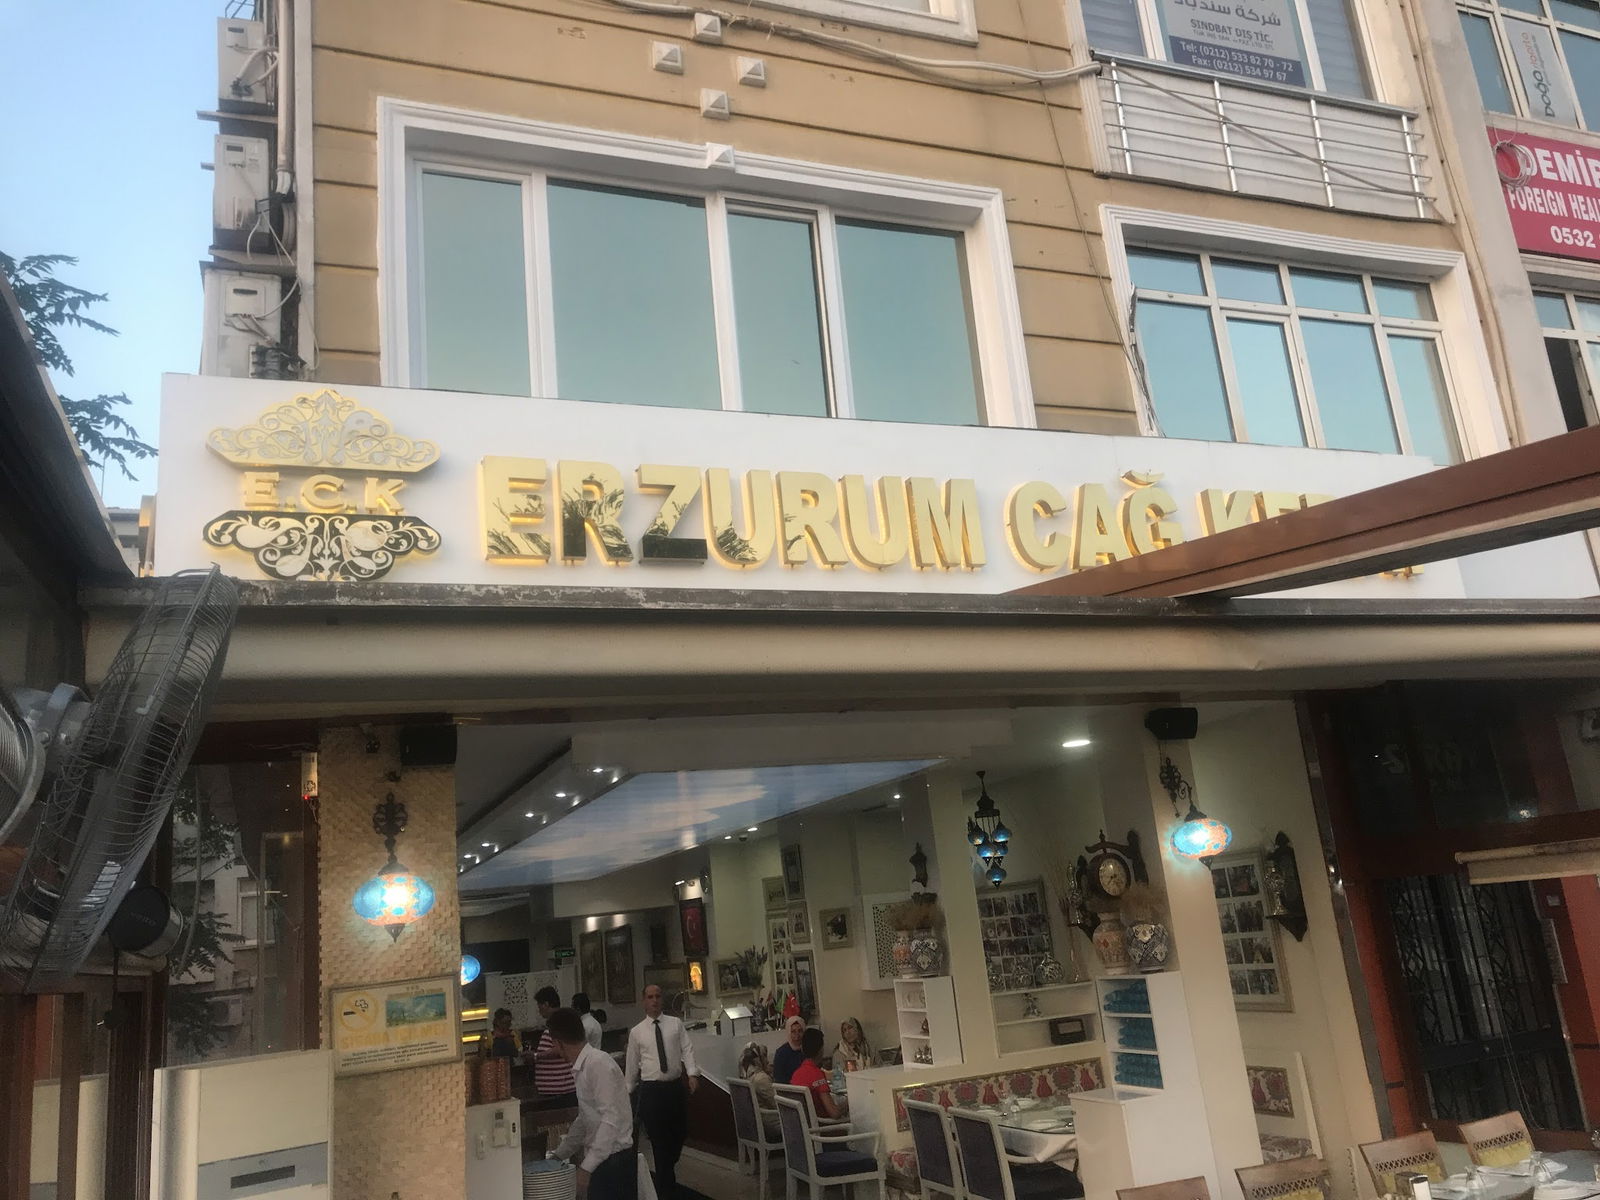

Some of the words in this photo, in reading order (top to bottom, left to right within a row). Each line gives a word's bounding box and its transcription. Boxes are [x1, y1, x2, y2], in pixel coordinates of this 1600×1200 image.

[1190, 19, 1233, 35] SINDBAT
[1180, 41, 1198, 53] Tel:
[1199, 45, 1230, 61] (0212)
[1231, 52, 1249, 63] 533
[1264, 58, 1275, 68] 70
[1281, 61, 1294, 72] 72
[1192, 55, 1211, 67] Fax:
[1213, 58, 1243, 75] (0212)
[1245, 65, 1262, 77] 534
[1506, 184, 1569, 218] FOREIGN
[1568, 193, 1600, 224] HEAL
[1550, 225, 1597, 249] 0532
[480, 455, 988, 571] ERZURUM
